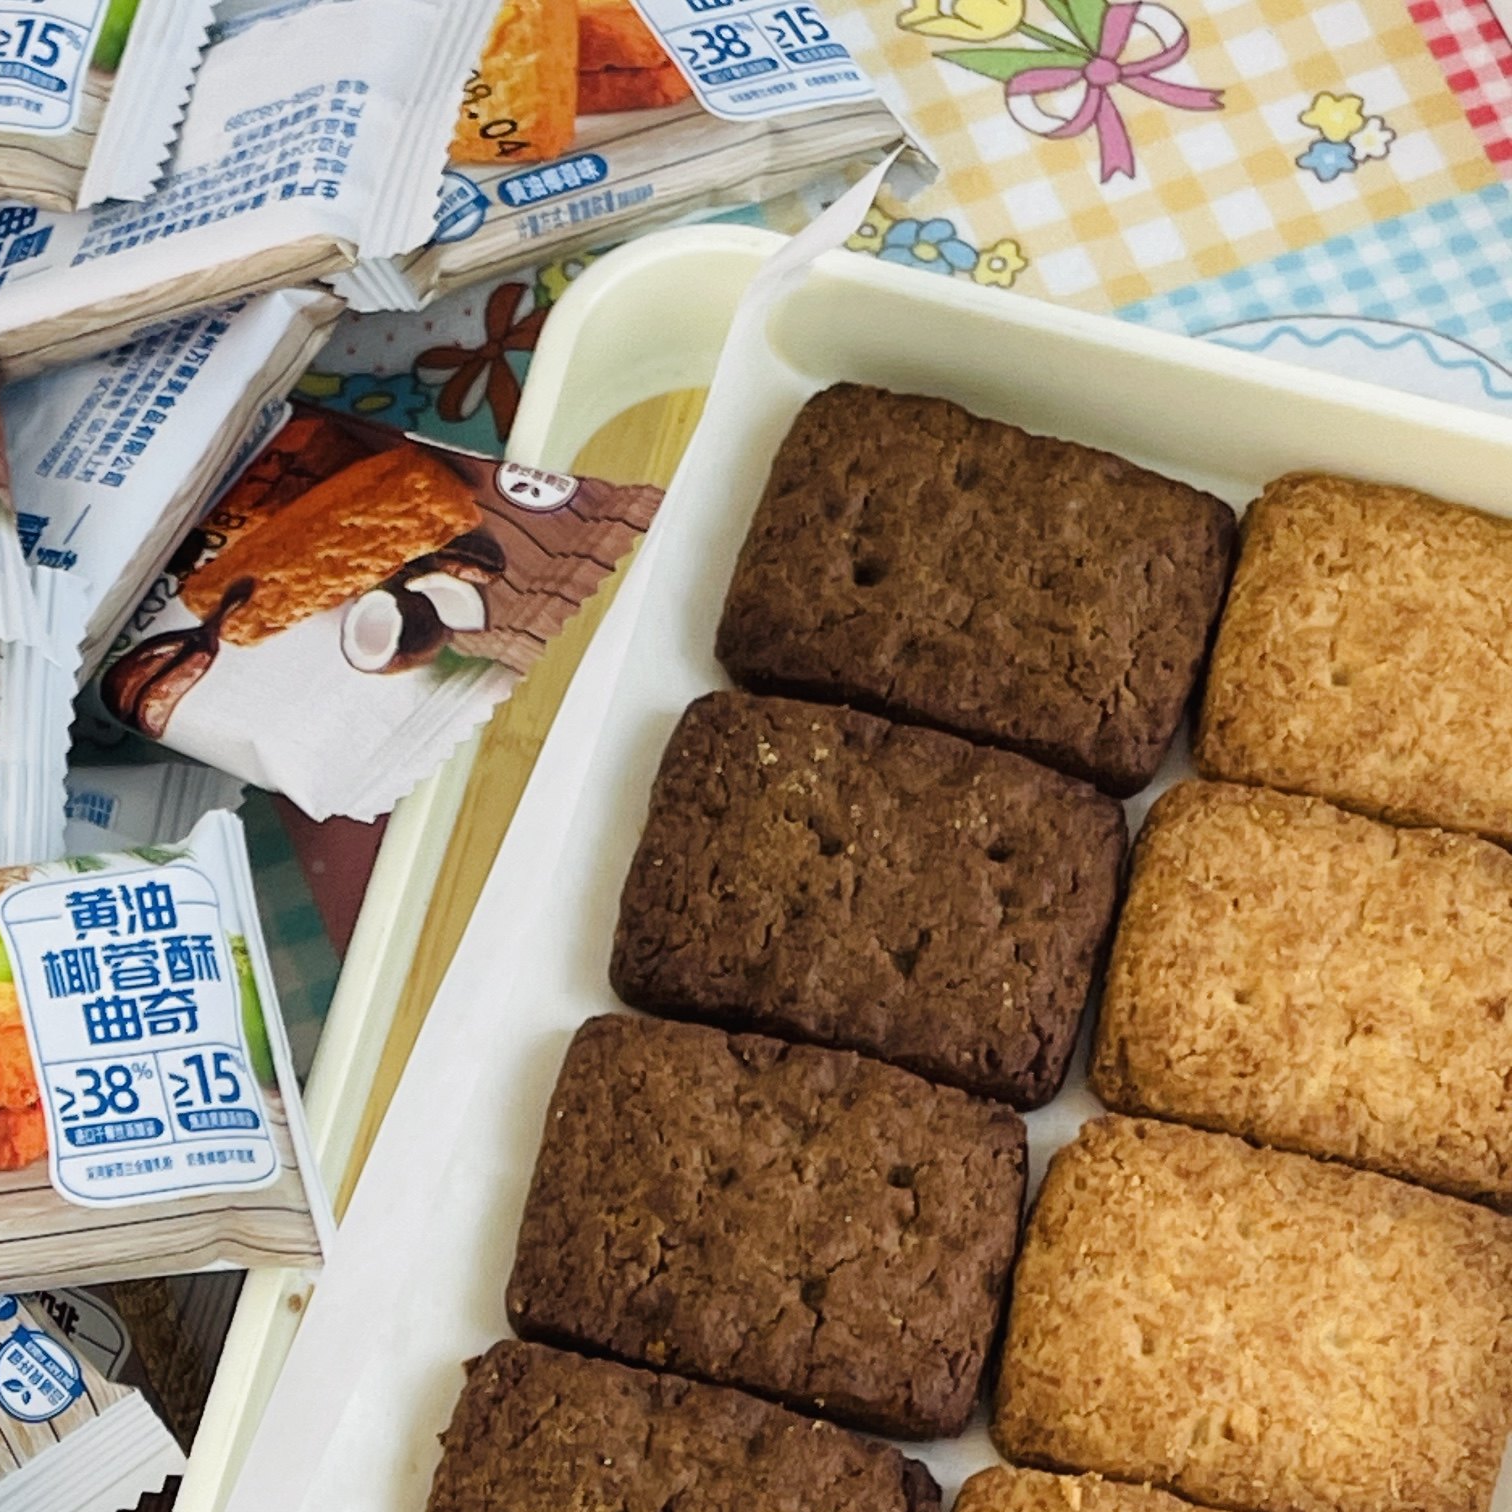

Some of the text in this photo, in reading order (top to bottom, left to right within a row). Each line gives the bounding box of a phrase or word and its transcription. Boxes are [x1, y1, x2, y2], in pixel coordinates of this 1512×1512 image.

[66, 881, 178, 940] 黄油
[42, 934, 220, 998] 椰蓉酥
[82, 989, 198, 1044] 曲奇
[56, 1062, 153, 1121] ≥38%
[168, 1053, 248, 1108] ≥15%
